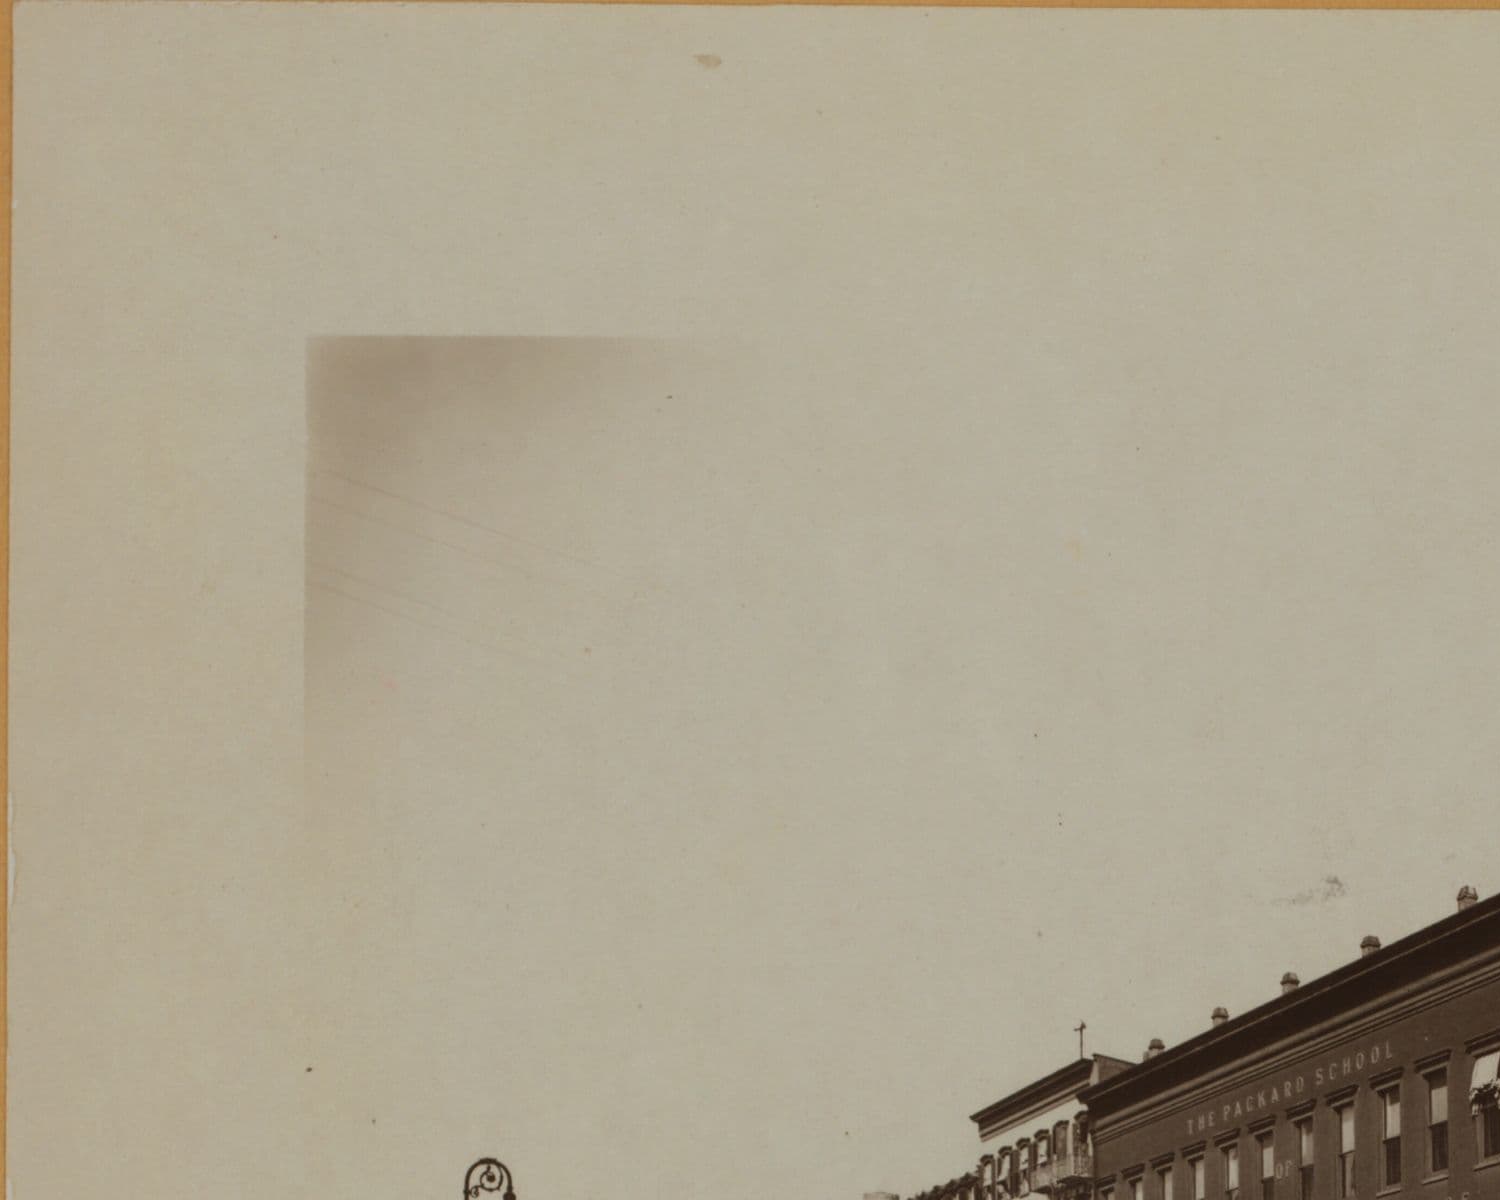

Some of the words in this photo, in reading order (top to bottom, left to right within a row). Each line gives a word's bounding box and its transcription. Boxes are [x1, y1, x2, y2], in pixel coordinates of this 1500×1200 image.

[1186, 1111, 1216, 1136] THE
[1223, 1075, 1305, 1121] PACKARD
[1315, 1041, 1394, 1086] SCHOOL
[1275, 1159, 1293, 1179] OF
